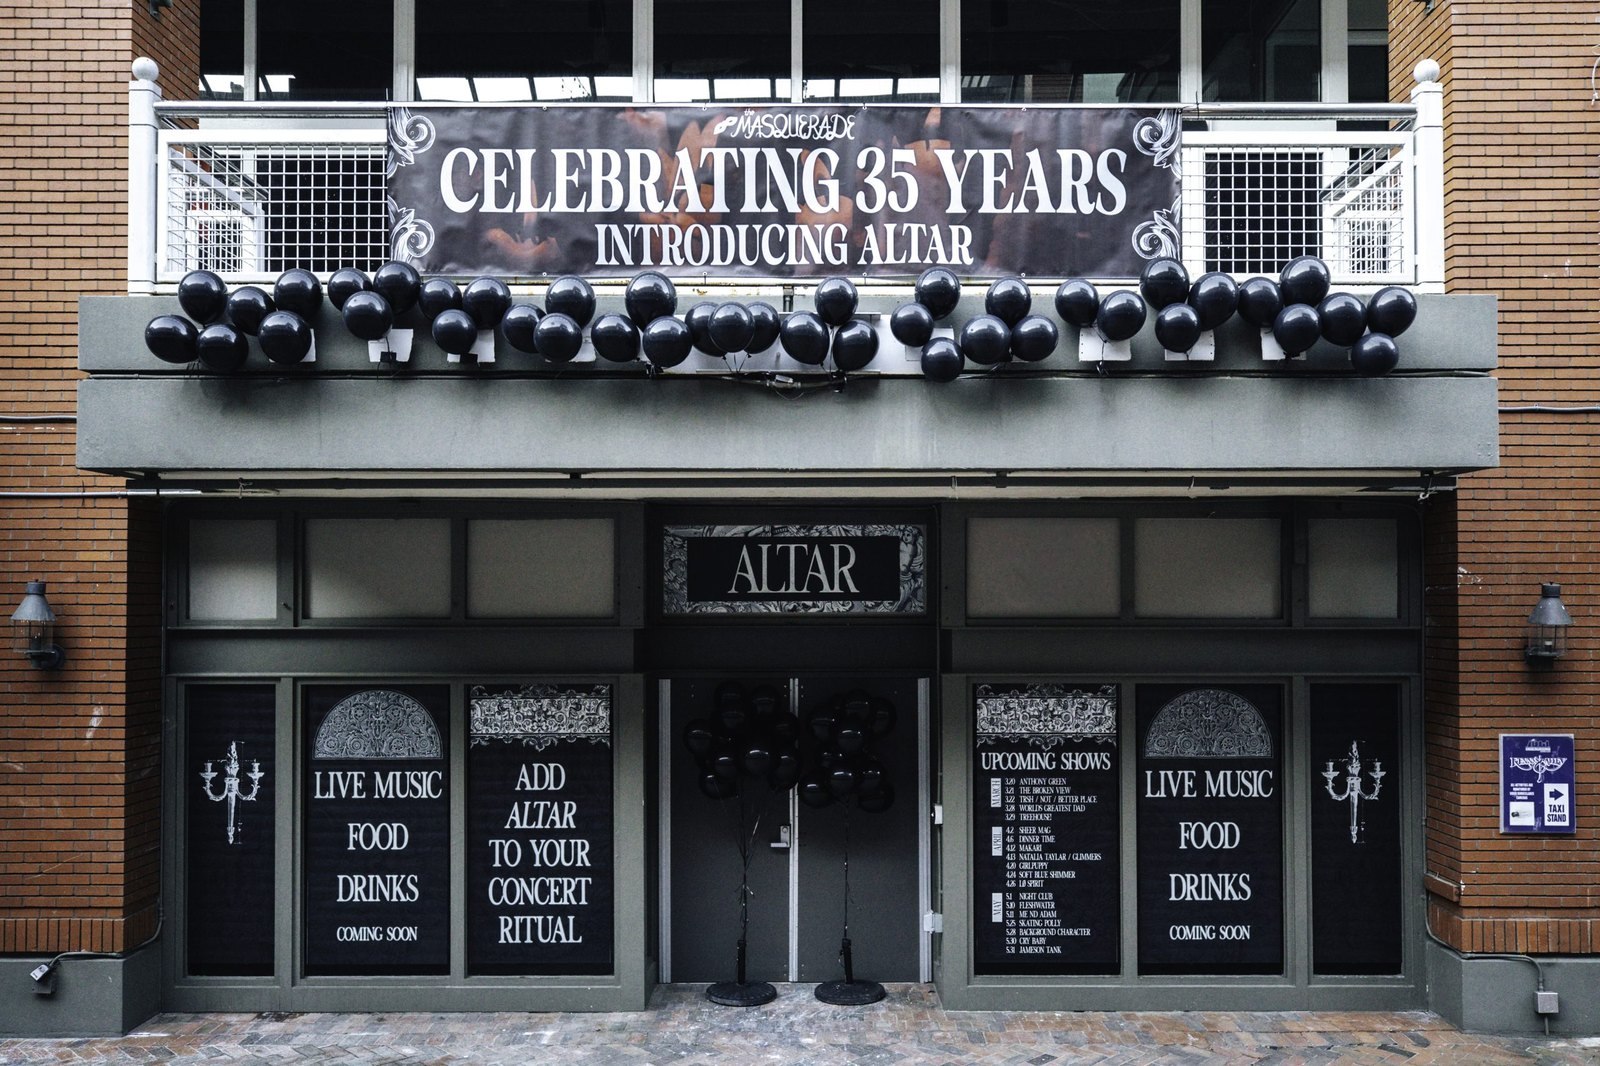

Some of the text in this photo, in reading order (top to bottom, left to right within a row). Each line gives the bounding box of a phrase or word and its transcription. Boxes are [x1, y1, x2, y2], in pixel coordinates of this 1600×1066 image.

[743, 109, 755, 117] the
[730, 113, 856, 141] MASQUERADE
[440, 146, 1127, 216] CELEBRATING 35 YEARS
[595, 223, 974, 266] INTRODUCING ALTAR
[727, 543, 860, 594] ALTAR
[981, 752, 1111, 771] UPCOMING SHOWS
[314, 770, 443, 799] LIVE MUSIC
[514, 762, 566, 791] ADD
[1019, 777, 1047, 786] ANTHONY
[1047, 777, 1067, 786] GREEN
[1145, 769, 1274, 798] LIVE MUSIC
[991, 779, 1001, 807] MARCH
[1019, 786, 1032, 794] THE
[1032, 786, 1055, 794] BROKEN
[1055, 786, 1072, 794] VIEW
[1019, 795, 1034, 803] TRSH
[1039, 795, 1053, 803] NOT
[1057, 795, 1079, 803] BETTER
[1080, 795, 1098, 803] PLACE
[503, 800, 577, 829] ALTAR
[1043, 804, 1072, 812] GREATEST
[1072, 804, 1086, 812] DAD
[1548, 804, 1565, 813] TAXI
[1547, 813, 1567, 822] STAND
[347, 822, 409, 851] FOOD
[1018, 826, 1037, 834] SHEER
[1037, 826, 1052, 834] MAG
[1178, 821, 1241, 850] FOOD
[993, 831, 1002, 852] APRIL
[1018, 835, 1040, 843] DINNER
[1041, 835, 1056, 843] TIME
[488, 838, 592, 867] TO YOUR
[1018, 844, 1043, 852] MAKARI
[1018, 853, 1044, 861] NATALIA
[1045, 853, 1067, 861] TAYLAR
[1072, 853, 1102, 861] GLIMMERS
[1018, 862, 1049, 870] GIRLPUPPY
[1018, 871, 1034, 879] SOFT
[1034, 871, 1049, 879] BLUE
[1049, 871, 1077, 879] SHIMMER
[336, 874, 420, 903] DRINKS
[488, 876, 592, 906] CONCERT
[1027, 880, 1045, 888] SPIRIT
[1168, 872, 1252, 902] DRINKS
[1018, 893, 1038, 901] NIGHT
[1038, 893, 1054, 901] CLUB
[993, 899, 1002, 916] MAY
[498, 915, 583, 944] RITUAL
[1018, 919, 1043, 927] SKATING
[1044, 919, 1062, 927] POLLY
[336, 926, 418, 942] COMING SOON
[1018, 928, 1057, 936] BACKGROUND
[1057, 928, 1091, 936] CHARACTER
[1169, 924, 1251, 941] COMING SOON
[1018, 937, 1031, 945] CRY
[1031, 937, 1047, 945] BABY
[1018, 946, 1045, 954] JAMESON
[1045, 946, 1062, 954] TANK
